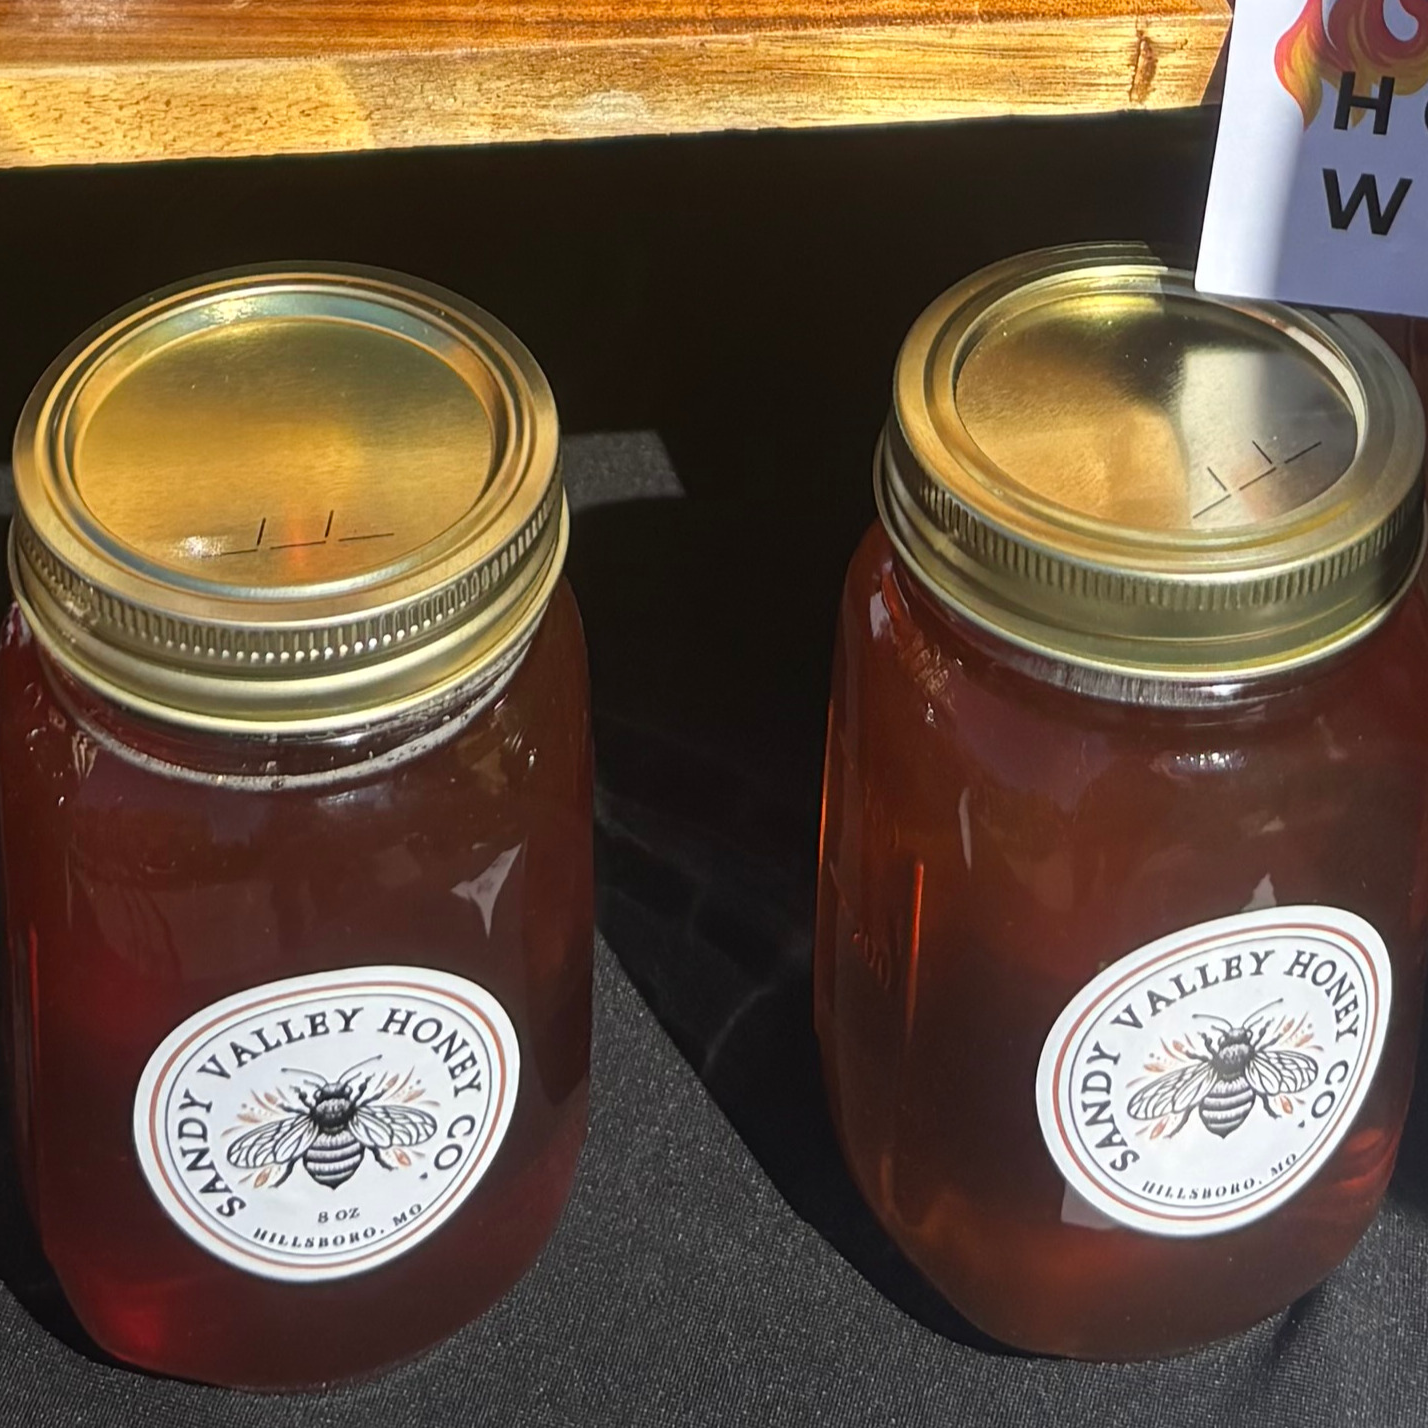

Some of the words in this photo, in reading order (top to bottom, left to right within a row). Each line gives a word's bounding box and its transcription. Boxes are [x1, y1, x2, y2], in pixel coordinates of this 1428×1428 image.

[1110, 949, 1276, 1032] VALLEY
[1283, 949, 1359, 1044] HONEY
[197, 1006, 365, 1083] VALLEY
[377, 1006, 483, 1098] HONEY
[1080, 1041, 1141, 1173] SANDY
[1297, 1058, 1349, 1129] CO.
[177, 1088, 247, 1219] SANDY
[419, 1113, 476, 1182] CO.
[1141, 1177, 1263, 1201] HILLSBORO,
[1270, 1152, 1297, 1177] MO
[253, 1226, 386, 1249] HILLSBORO,
[392, 1202, 424, 1227] MO
[317, 1211, 330, 1224] 8
[334, 1206, 361, 1222] OZ
